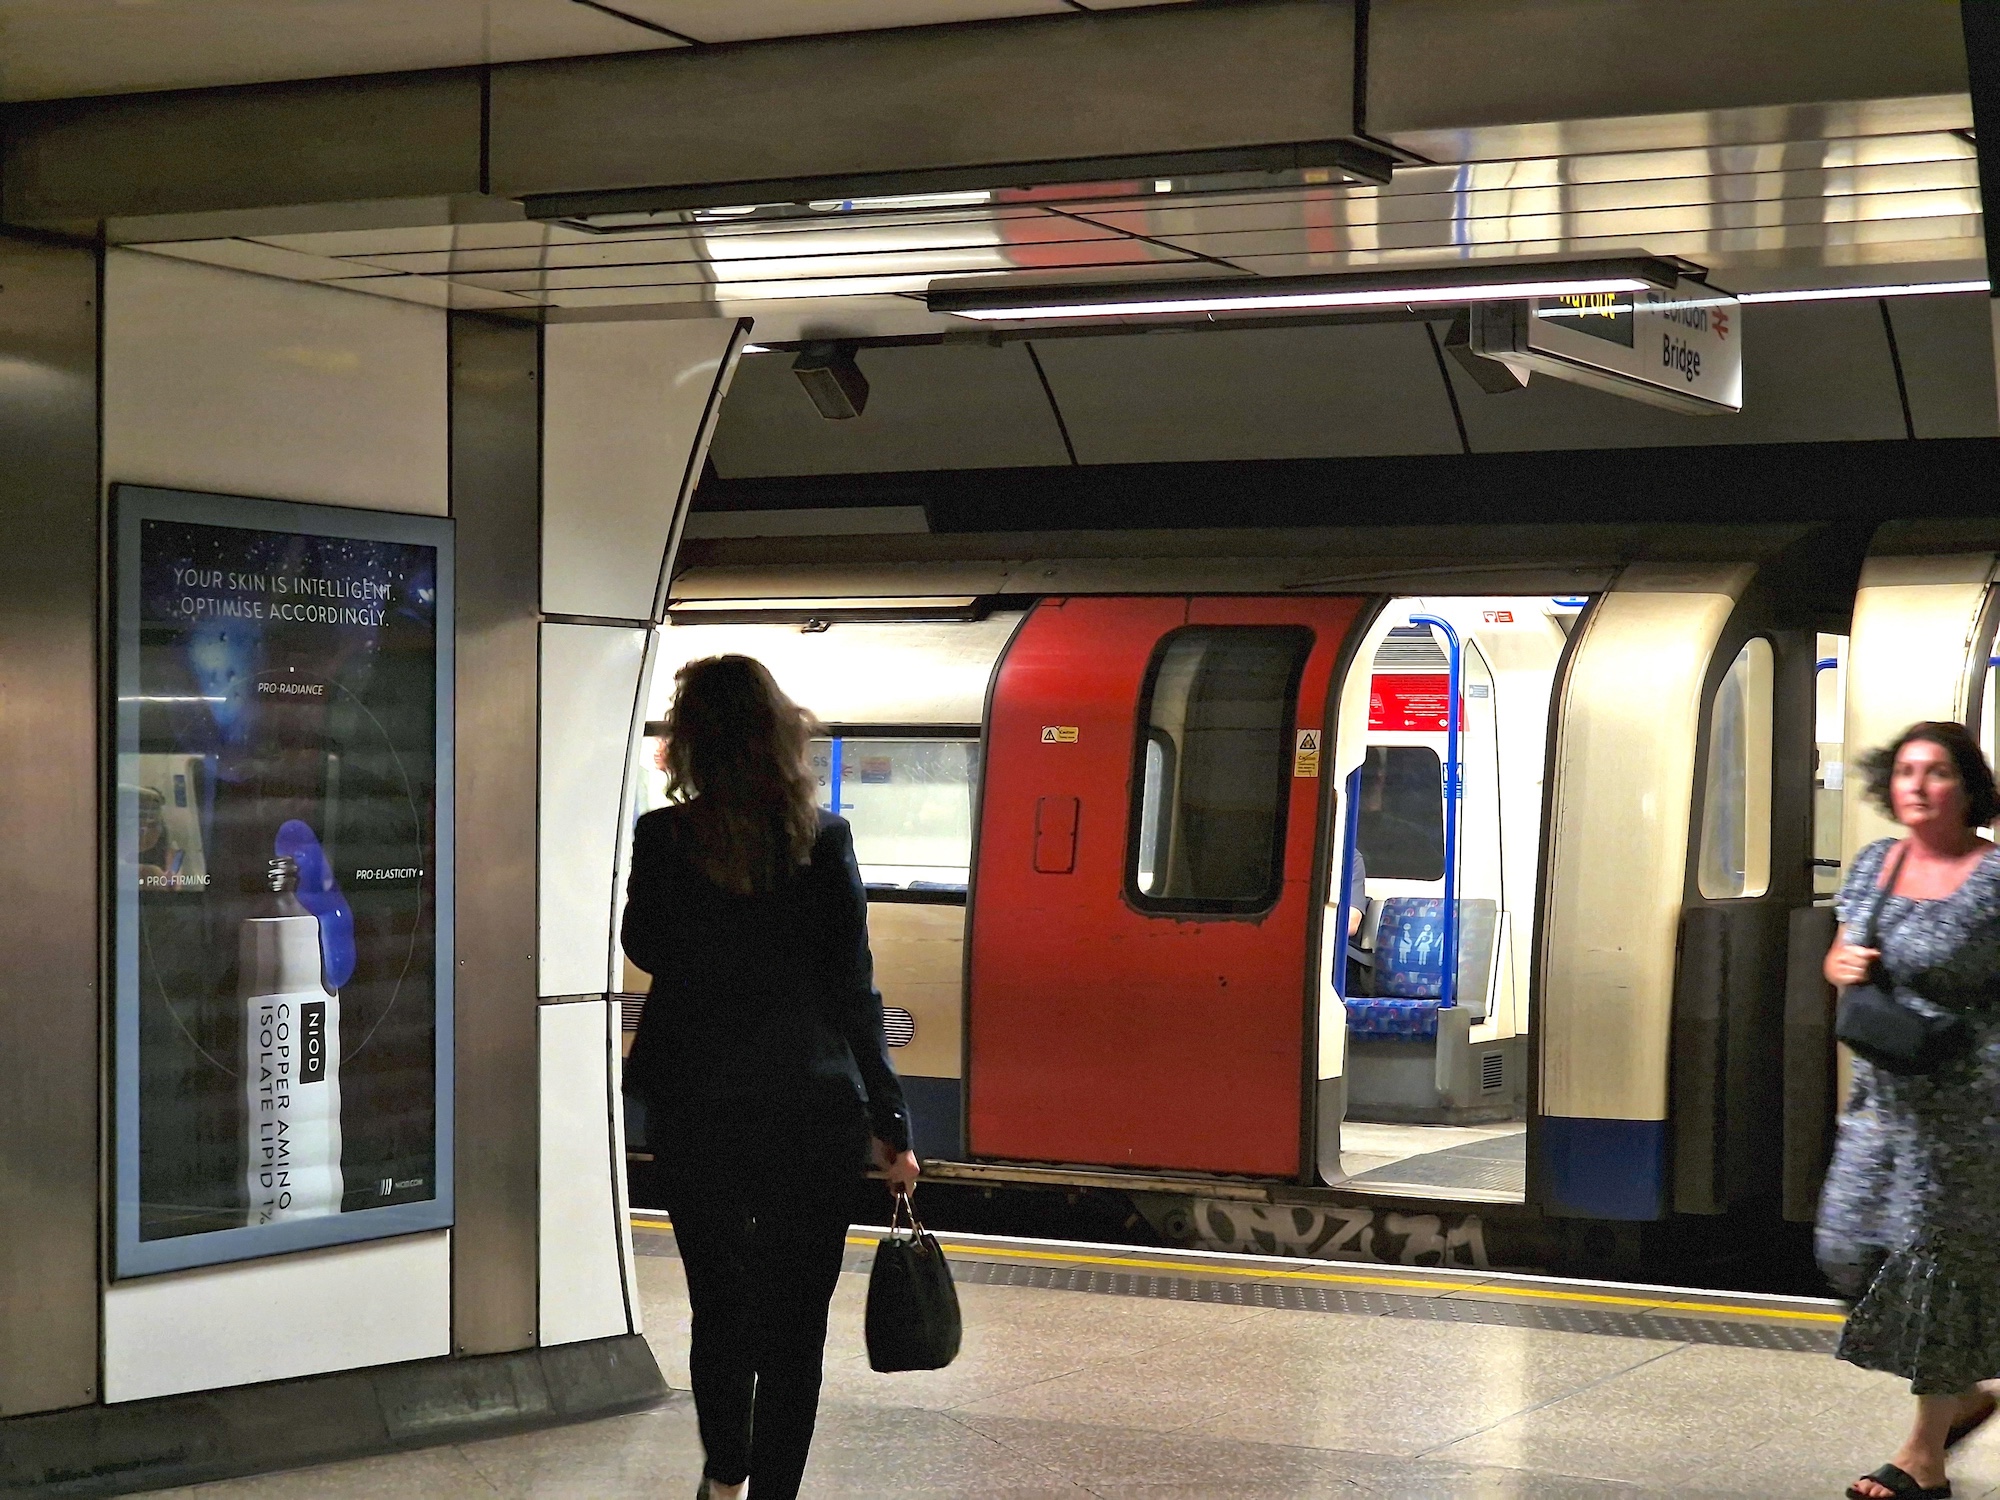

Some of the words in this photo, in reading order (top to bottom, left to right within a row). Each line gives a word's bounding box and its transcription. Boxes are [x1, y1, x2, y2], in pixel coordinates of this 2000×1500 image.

[1559, 295, 1587, 318] ay
[1590, 293, 1616, 320] out
[1663, 333, 1700, 382] Bridge
[173, 567, 223, 589] YOUR
[229, 572, 266, 592] SKIN
[272, 576, 288, 594] IS
[294, 577, 397, 602] INTELLIGENT.
[181, 596, 264, 619] OPTIMISE
[269, 603, 390, 627] ACCORDINGLY.
[257, 682, 324, 696] PRO-RADIANCE
[146, 874, 211, 887] PRO-FIRMING
[355, 868, 418, 880] PRO-ELASTICITY
[260, 1006, 274, 1112] ISOLATE
[276, 1003, 290, 1109] COPPER
[308, 1012, 320, 1072] NIOD
[260, 1123, 274, 1189] LIPID
[277, 1119, 292, 1210] AMINO
[259, 1198, 275, 1225] 1%
